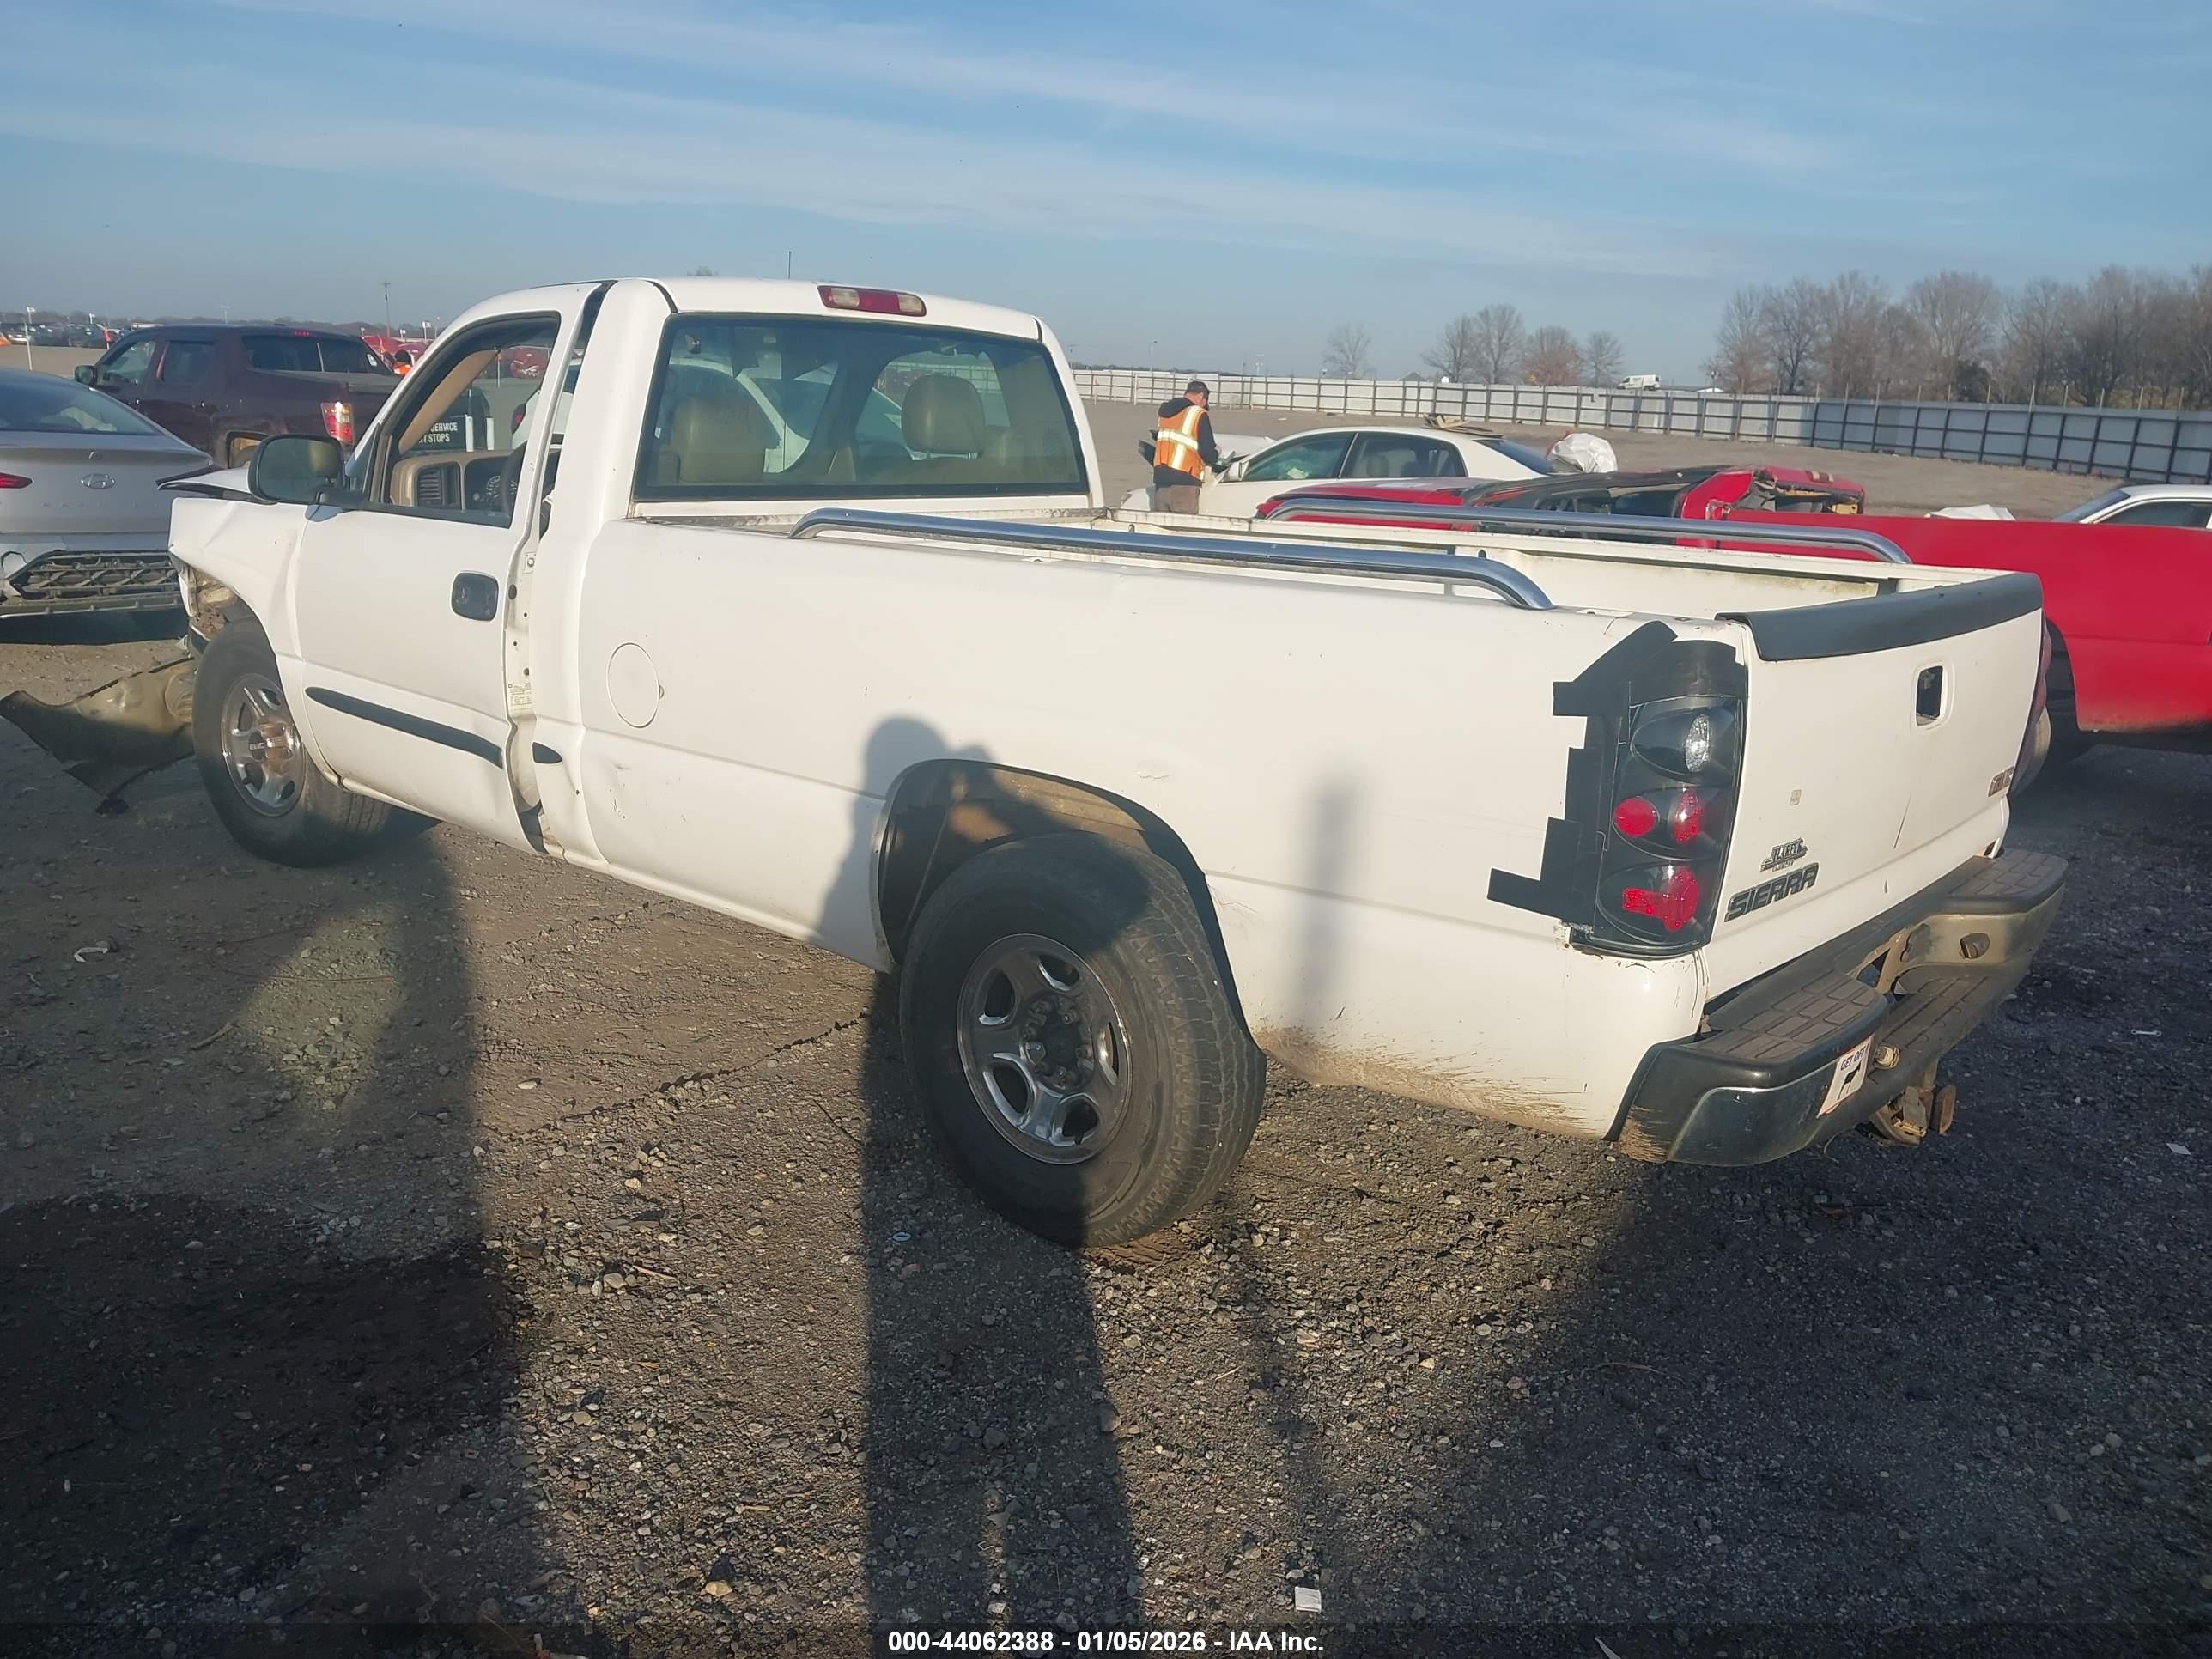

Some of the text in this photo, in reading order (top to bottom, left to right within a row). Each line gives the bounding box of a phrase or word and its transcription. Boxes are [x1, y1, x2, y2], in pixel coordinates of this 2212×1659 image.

[428, 433, 451, 443] STOPS
[1725, 862, 1819, 922] SIERRA
[1840, 1056, 1854, 1071] GET
